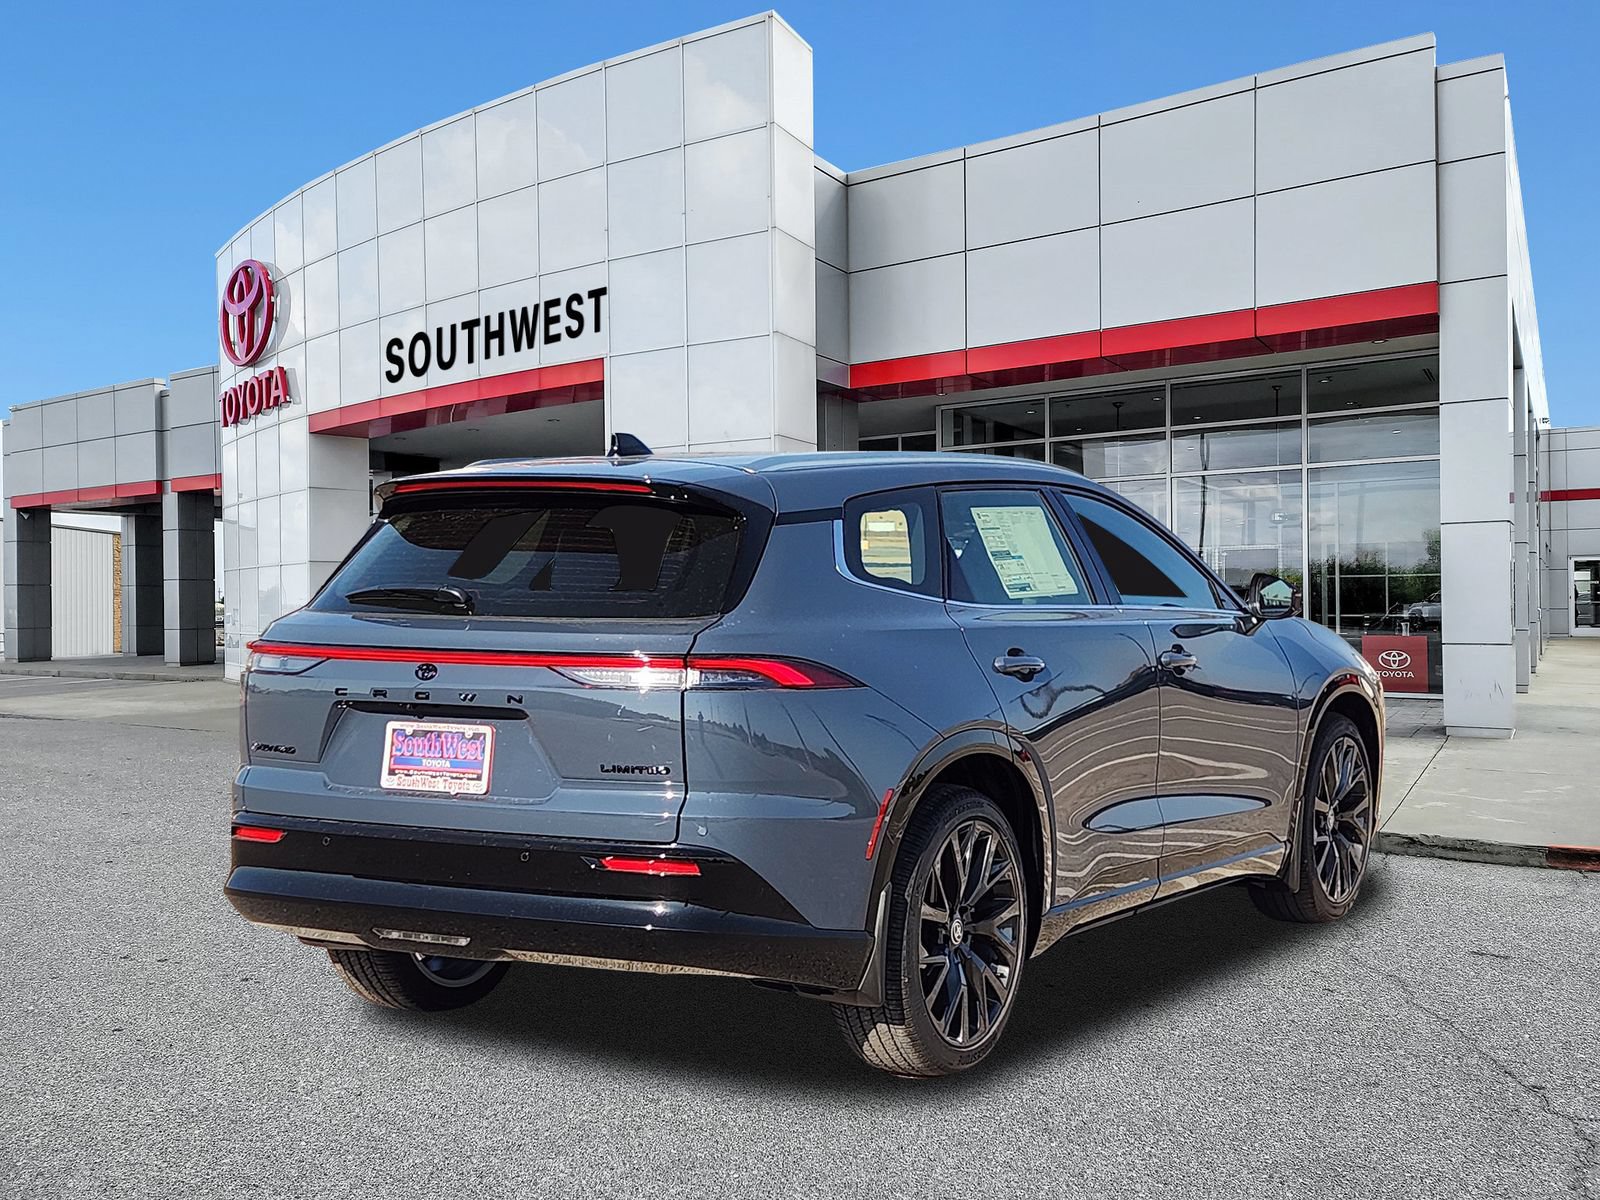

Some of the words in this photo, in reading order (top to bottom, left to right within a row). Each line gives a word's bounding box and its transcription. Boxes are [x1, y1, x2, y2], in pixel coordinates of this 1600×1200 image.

[385, 287, 607, 384] SOUTHWEST
[218, 366, 291, 428] TOYOTA
[392, 730, 485, 760] SouthWest
[422, 759, 451, 768] TOYOTA
